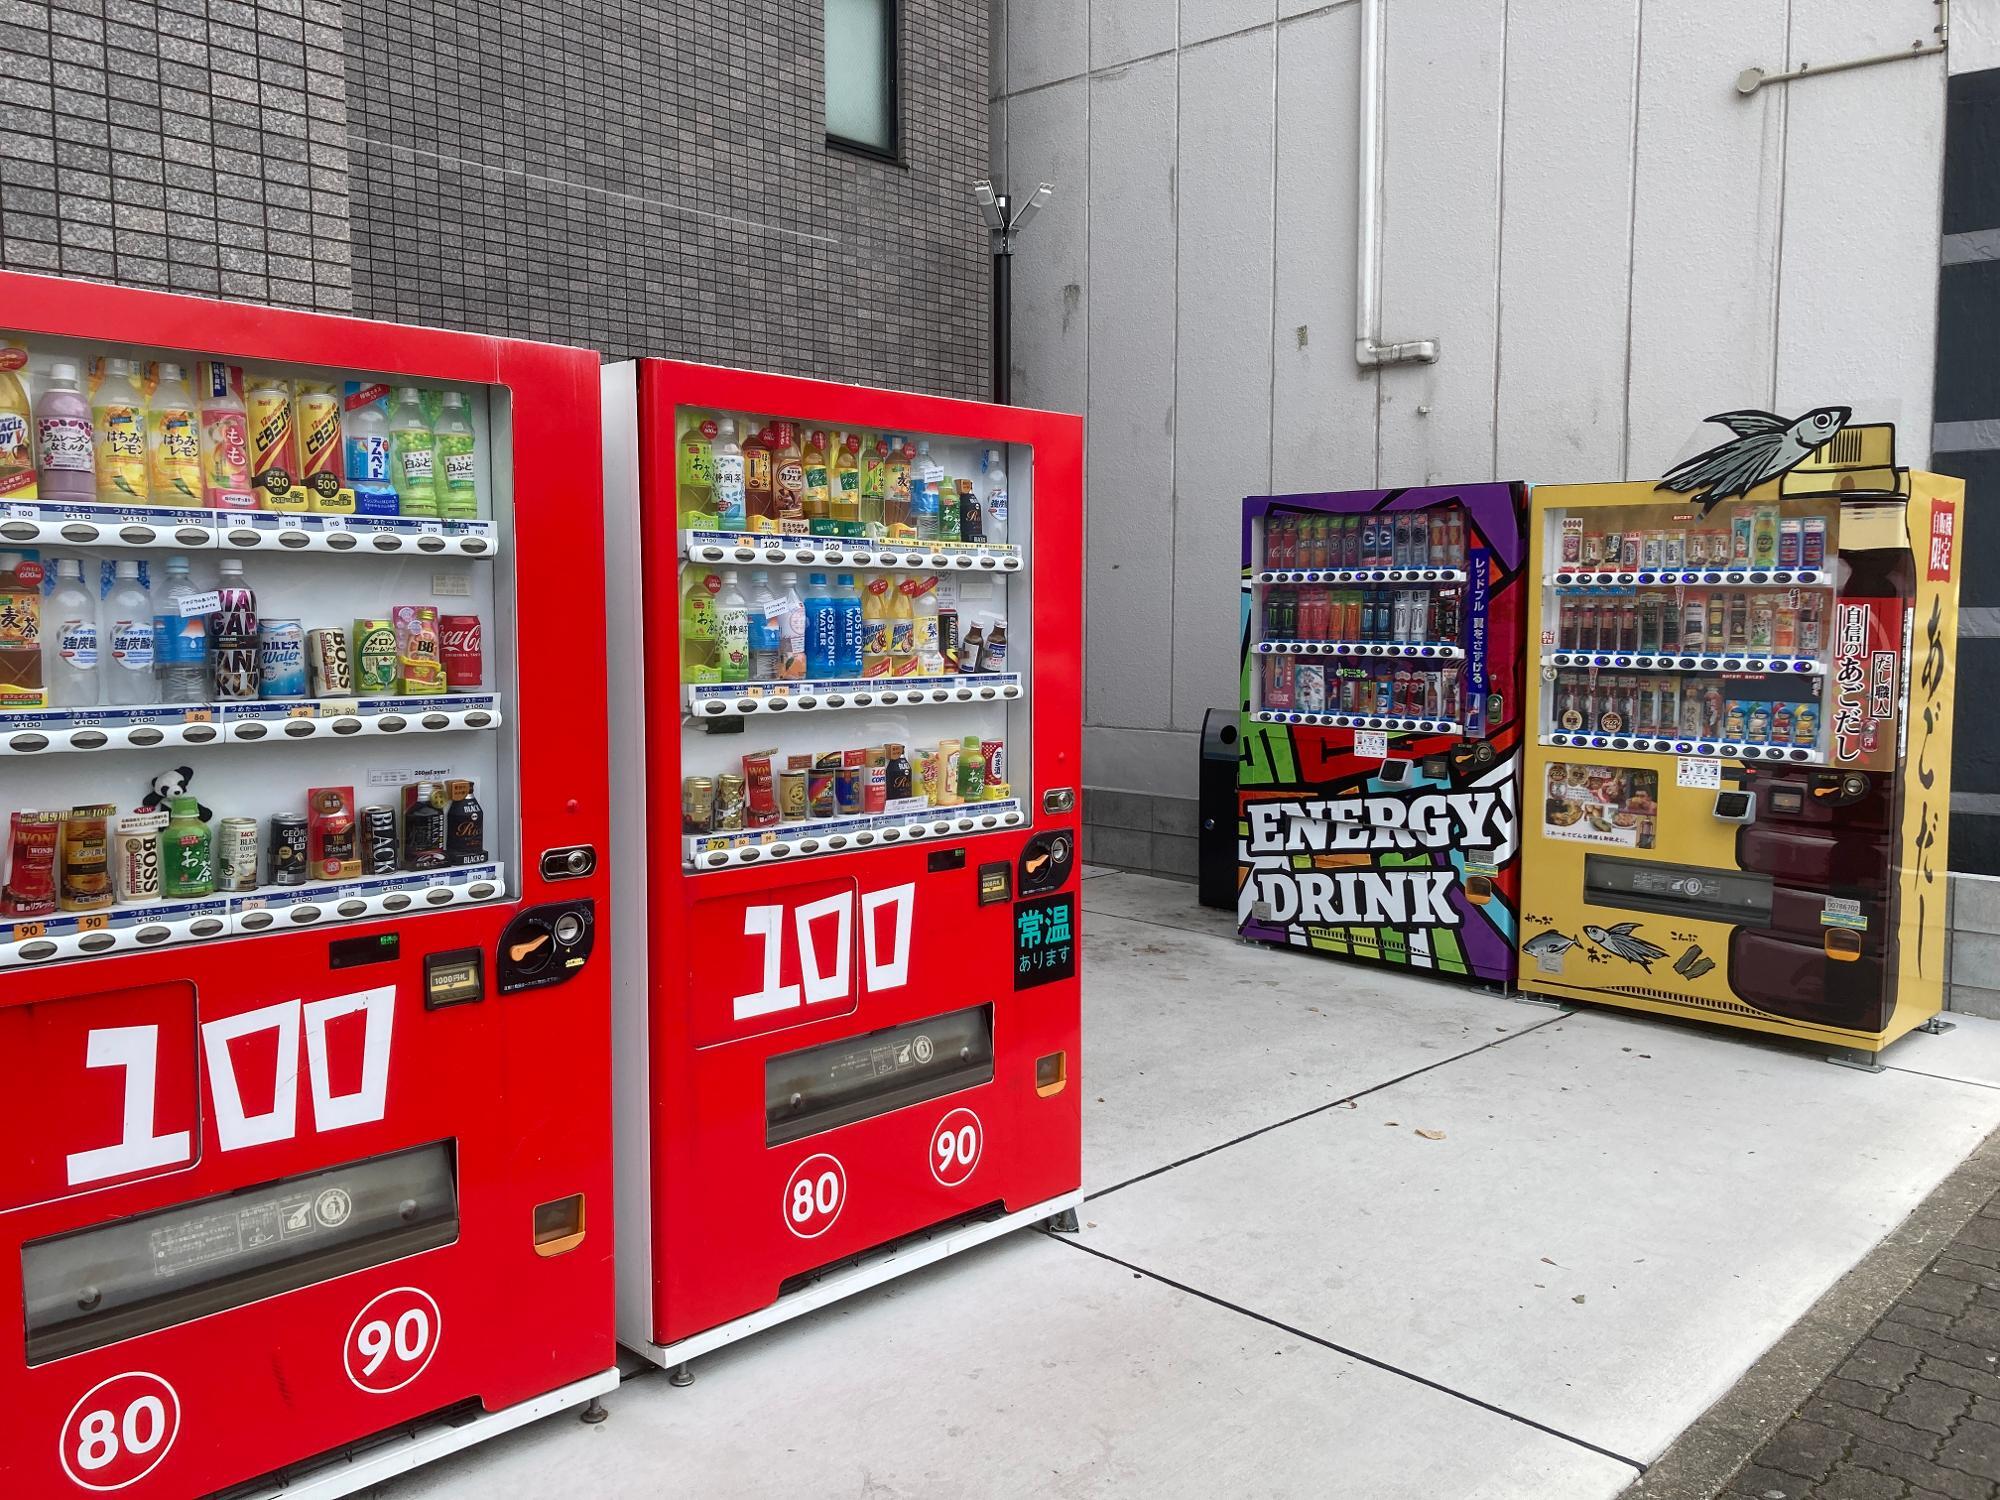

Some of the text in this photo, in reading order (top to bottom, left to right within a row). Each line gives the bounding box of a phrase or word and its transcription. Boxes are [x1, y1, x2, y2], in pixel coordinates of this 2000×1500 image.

[44, 432, 92, 445] ラムレーズン
[227, 428, 246, 465] もも
[406, 459, 433, 469] 白ぶど
[447, 462, 475, 472] 白ぶど
[267, 477, 288, 487] 500
[318, 480, 337, 490] 500
[122, 515, 148, 523] ¥110
[764, 541, 780, 549] 100
[824, 543, 840, 551] 100
[1473, 558, 1485, 612] レッドブル
[950, 617, 958, 650] ENERGY
[1842, 605, 1863, 656] 自信の
[263, 641, 300, 650] カルピス
[417, 641, 434, 653] BB
[262, 650, 301, 664] Water
[334, 631, 351, 690] BOSS
[1875, 656, 1891, 715] だし職人
[1834, 656, 1864, 761] あごだし
[194, 713, 205, 721] 80
[12, 721, 41, 729] ¥100
[1247, 791, 1496, 851] ENERGY
[372, 813, 396, 875] BLACK
[713, 841, 725, 849] 70
[143, 838, 158, 893] BOSS
[463, 856, 480, 864] BLACK
[1257, 871, 1460, 924] DRINK
[136, 915, 162, 923] ¥100
[190, 909, 213, 917] ¥100
[86, 917, 101, 928] 90
[1018, 904, 1071, 949] 常温
[22, 926, 38, 936] 90
[1671, 931, 1699, 943] こんぶ
[733, 882, 916, 1021] 100
[1019, 946, 1070, 973] あります
[435, 973, 467, 985] 1000円札
[67, 984, 397, 1186] 100
[937, 1125, 977, 1173] 90
[791, 1171, 839, 1223] 80
[356, 1308, 429, 1377] 90
[77, 1395, 166, 1471] 80
